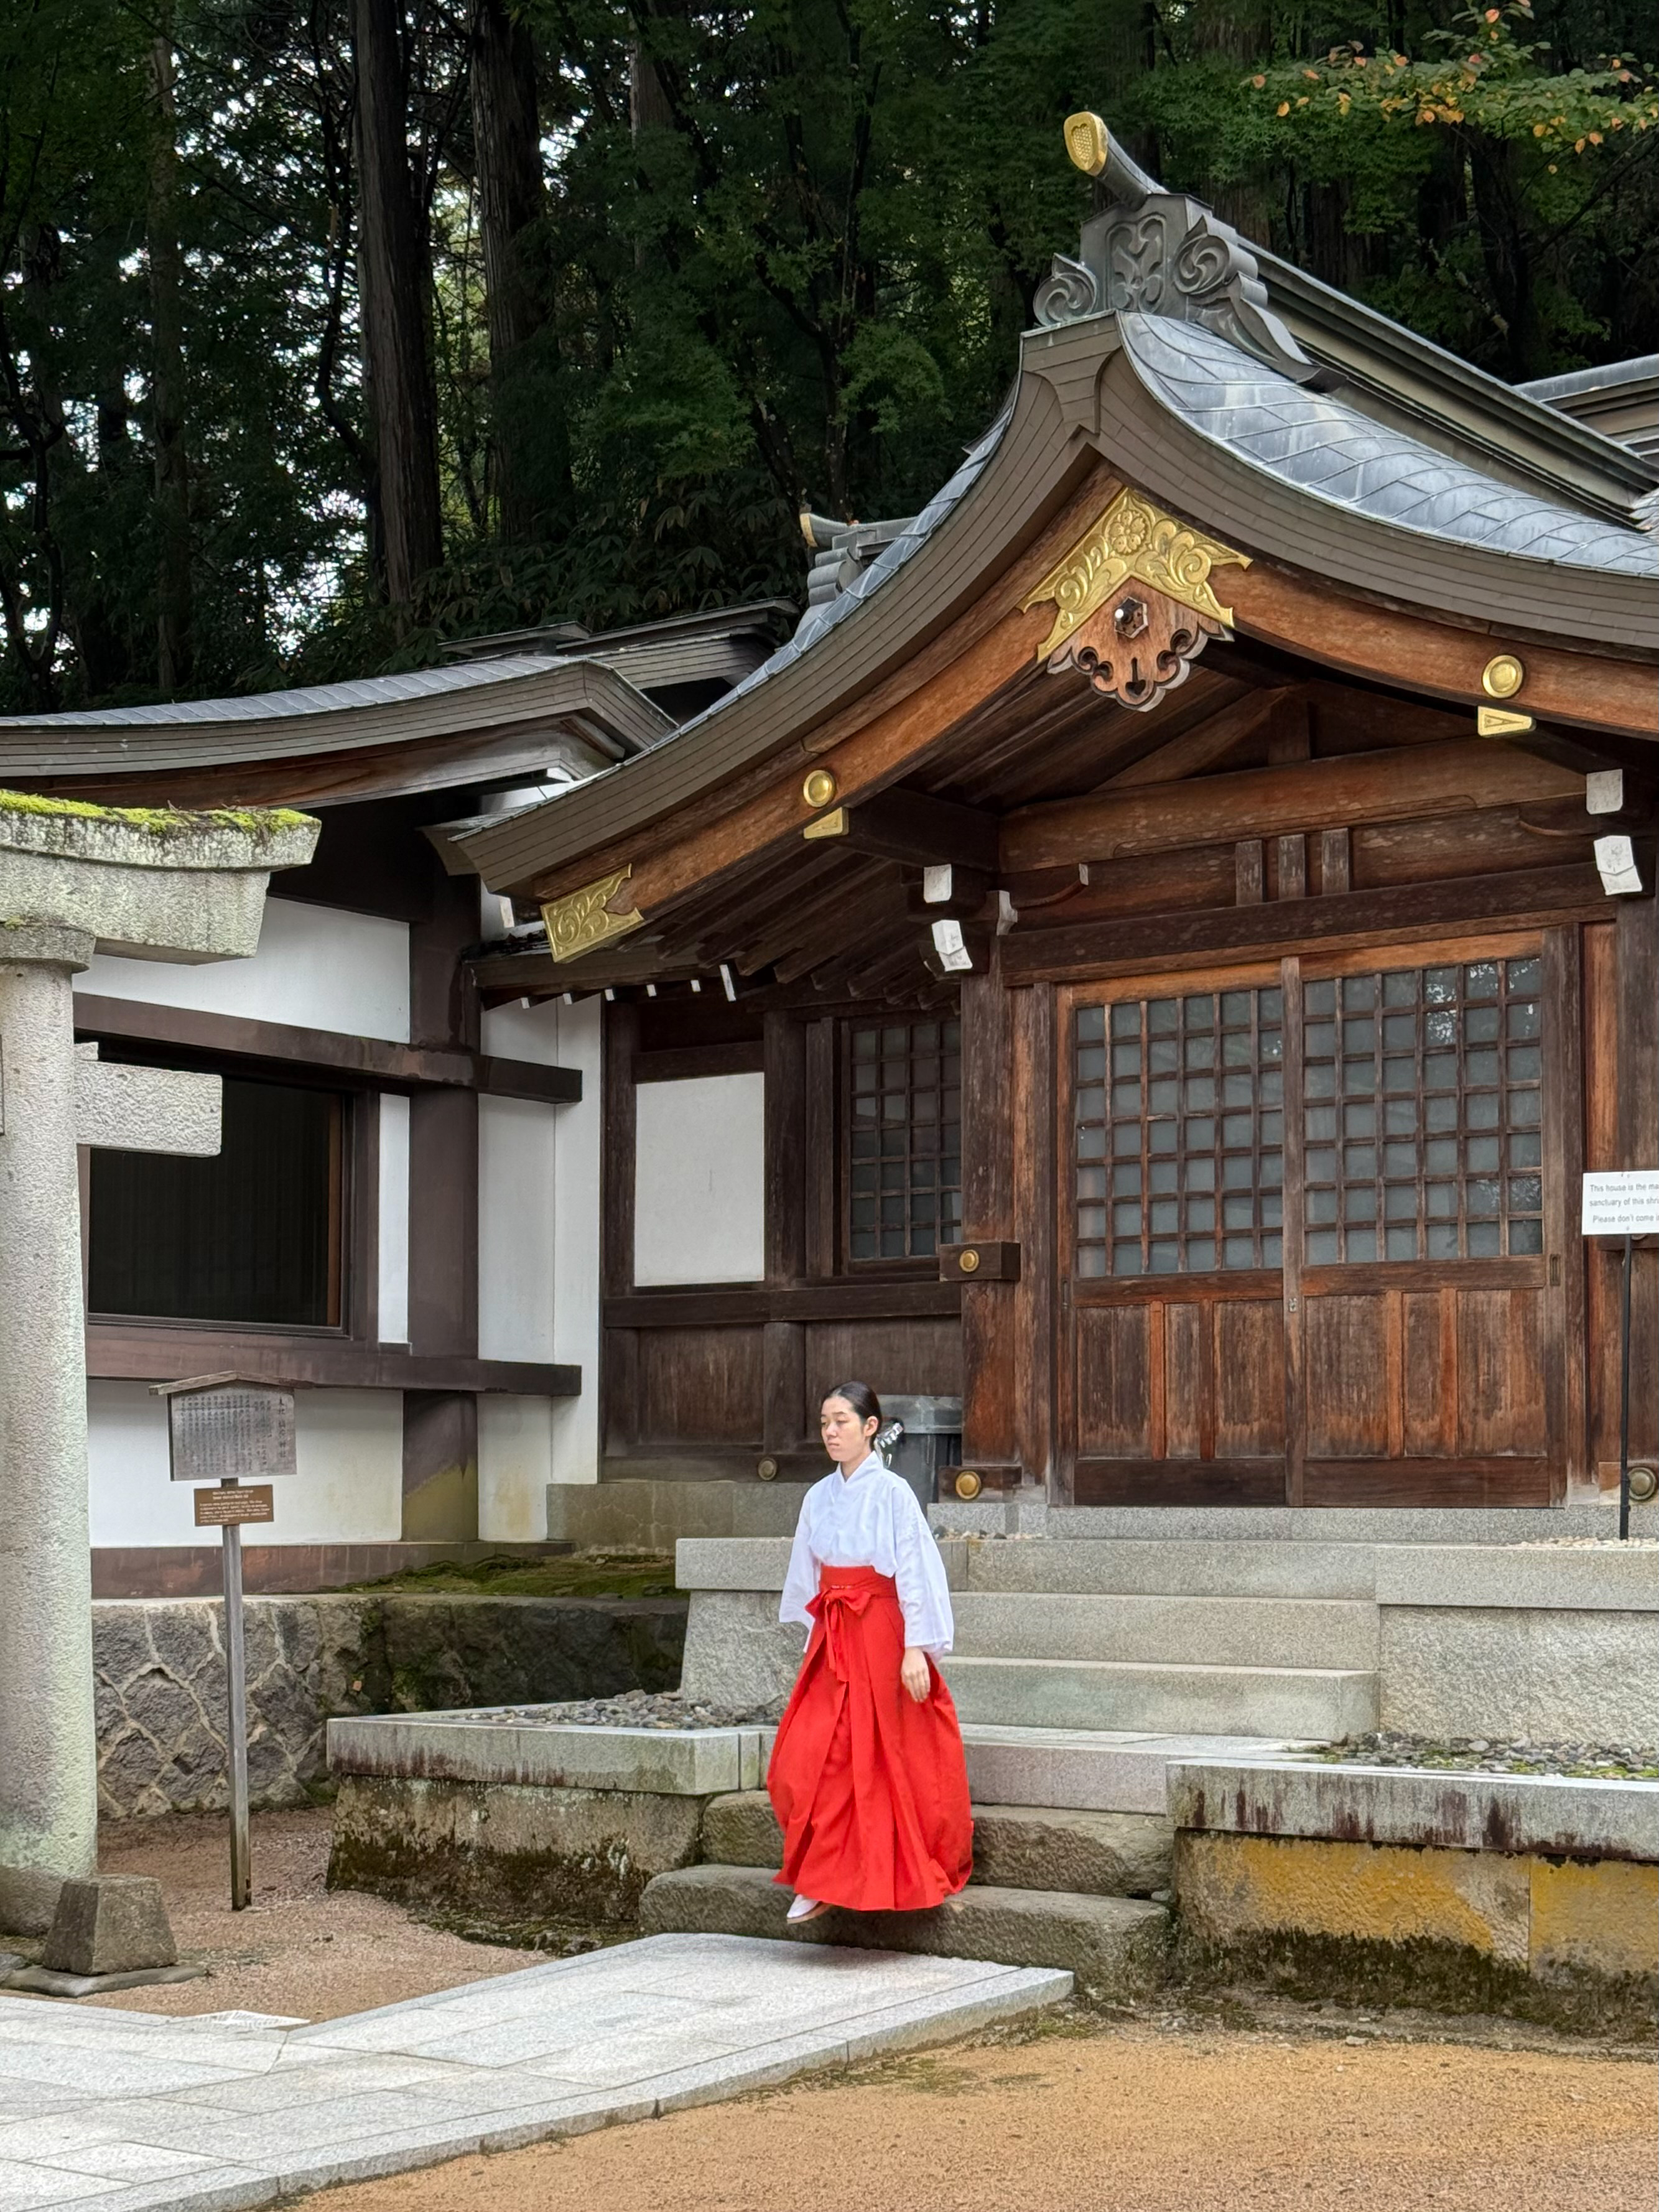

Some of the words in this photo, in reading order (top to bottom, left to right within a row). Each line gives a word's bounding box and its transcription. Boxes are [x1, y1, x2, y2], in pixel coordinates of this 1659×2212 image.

[1589, 1199, 1621, 1207] sanctuary
[1624, 1197, 1630, 1206] of
[1592, 1215, 1615, 1223] Please
[1617, 1214, 1633, 1222] don't
